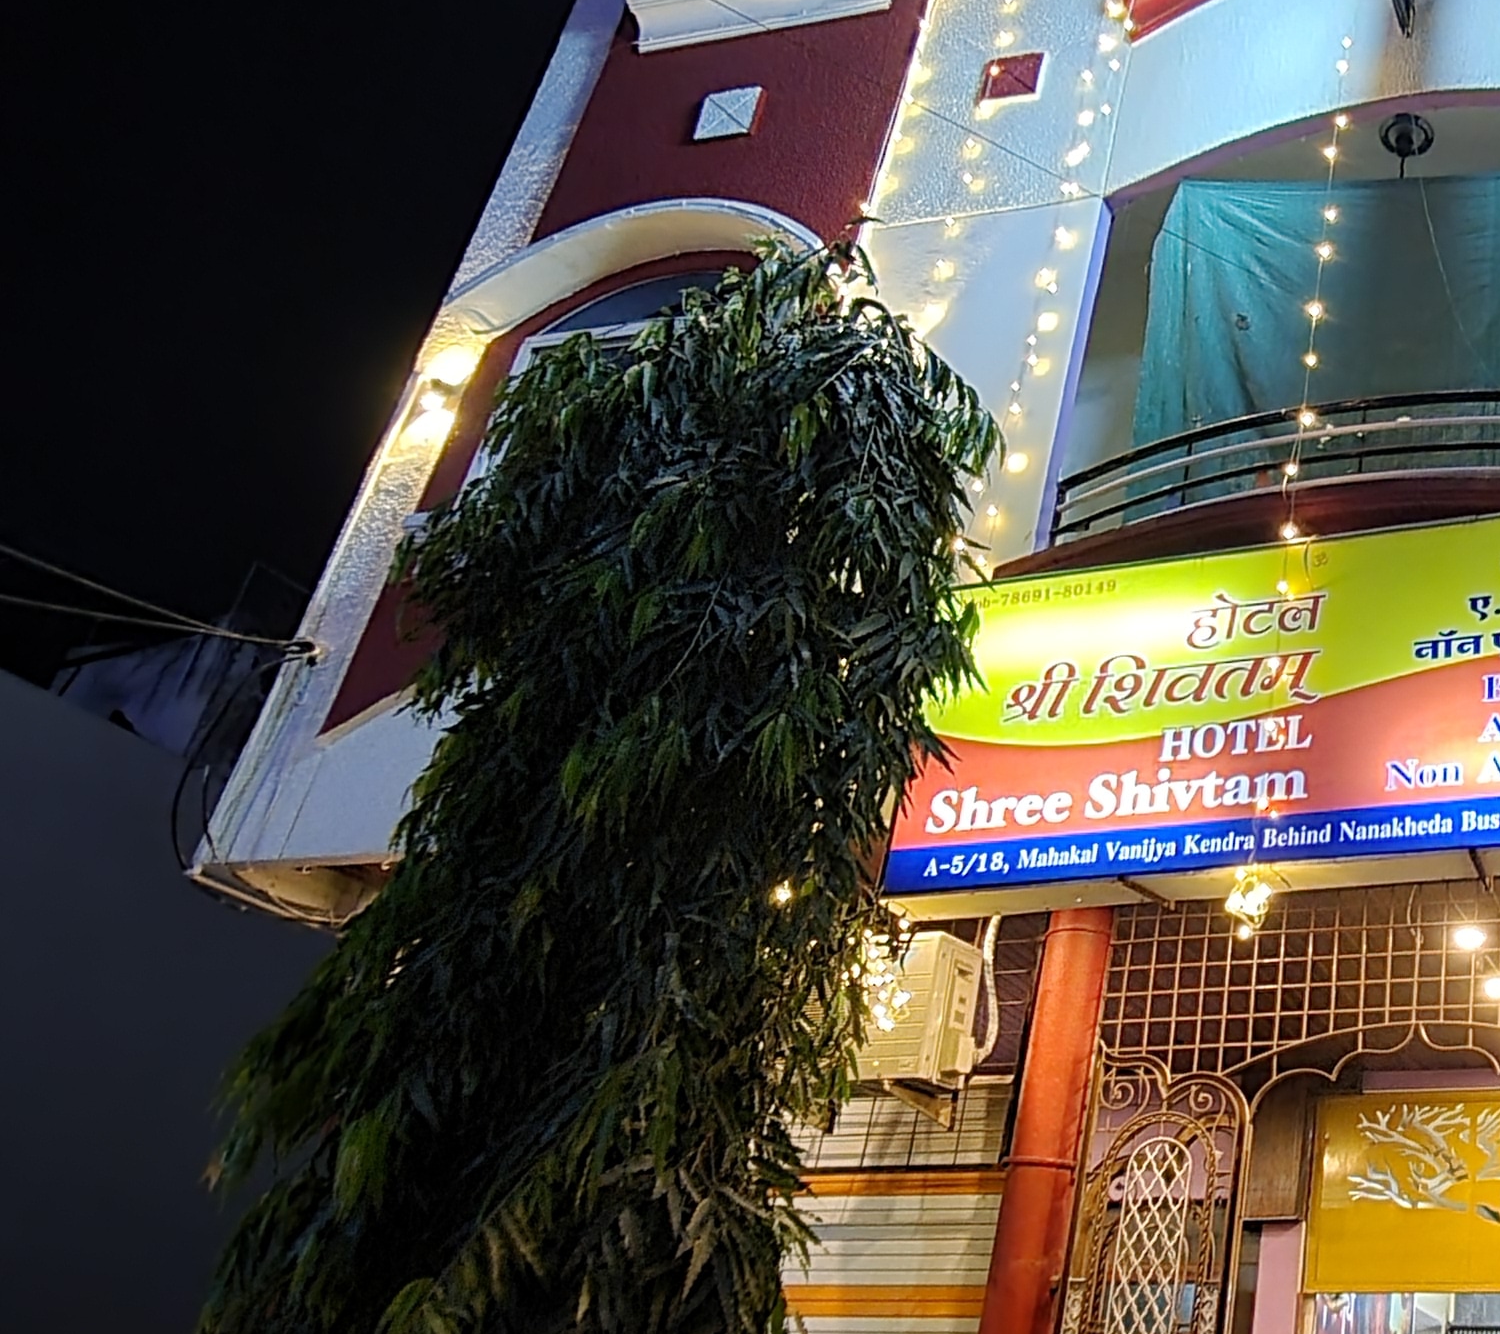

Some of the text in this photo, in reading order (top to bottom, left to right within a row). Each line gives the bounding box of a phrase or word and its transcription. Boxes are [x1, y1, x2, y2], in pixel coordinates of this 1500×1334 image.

[964, 578, 1117, 610] ob-78691-80149
[1187, 592, 1327, 649] होटल
[1413, 628, 1484, 661] नॉन
[1001, 651, 1321, 724] श्री शिवतम्
[1158, 715, 1312, 763] HOTEL
[924, 767, 1309, 835] Shree Shivtam
[1384, 758, 1464, 792] Non
[923, 851, 1010, 878] A-5/18,
[1016, 843, 1098, 870] Mahakal
[1105, 837, 1177, 864] Vanijya
[1183, 828, 1255, 857] Kendra
[1263, 824, 1332, 849] Behind
[1338, 814, 1453, 844] Nanakheda
[1460, 809, 1500, 833] Bus
